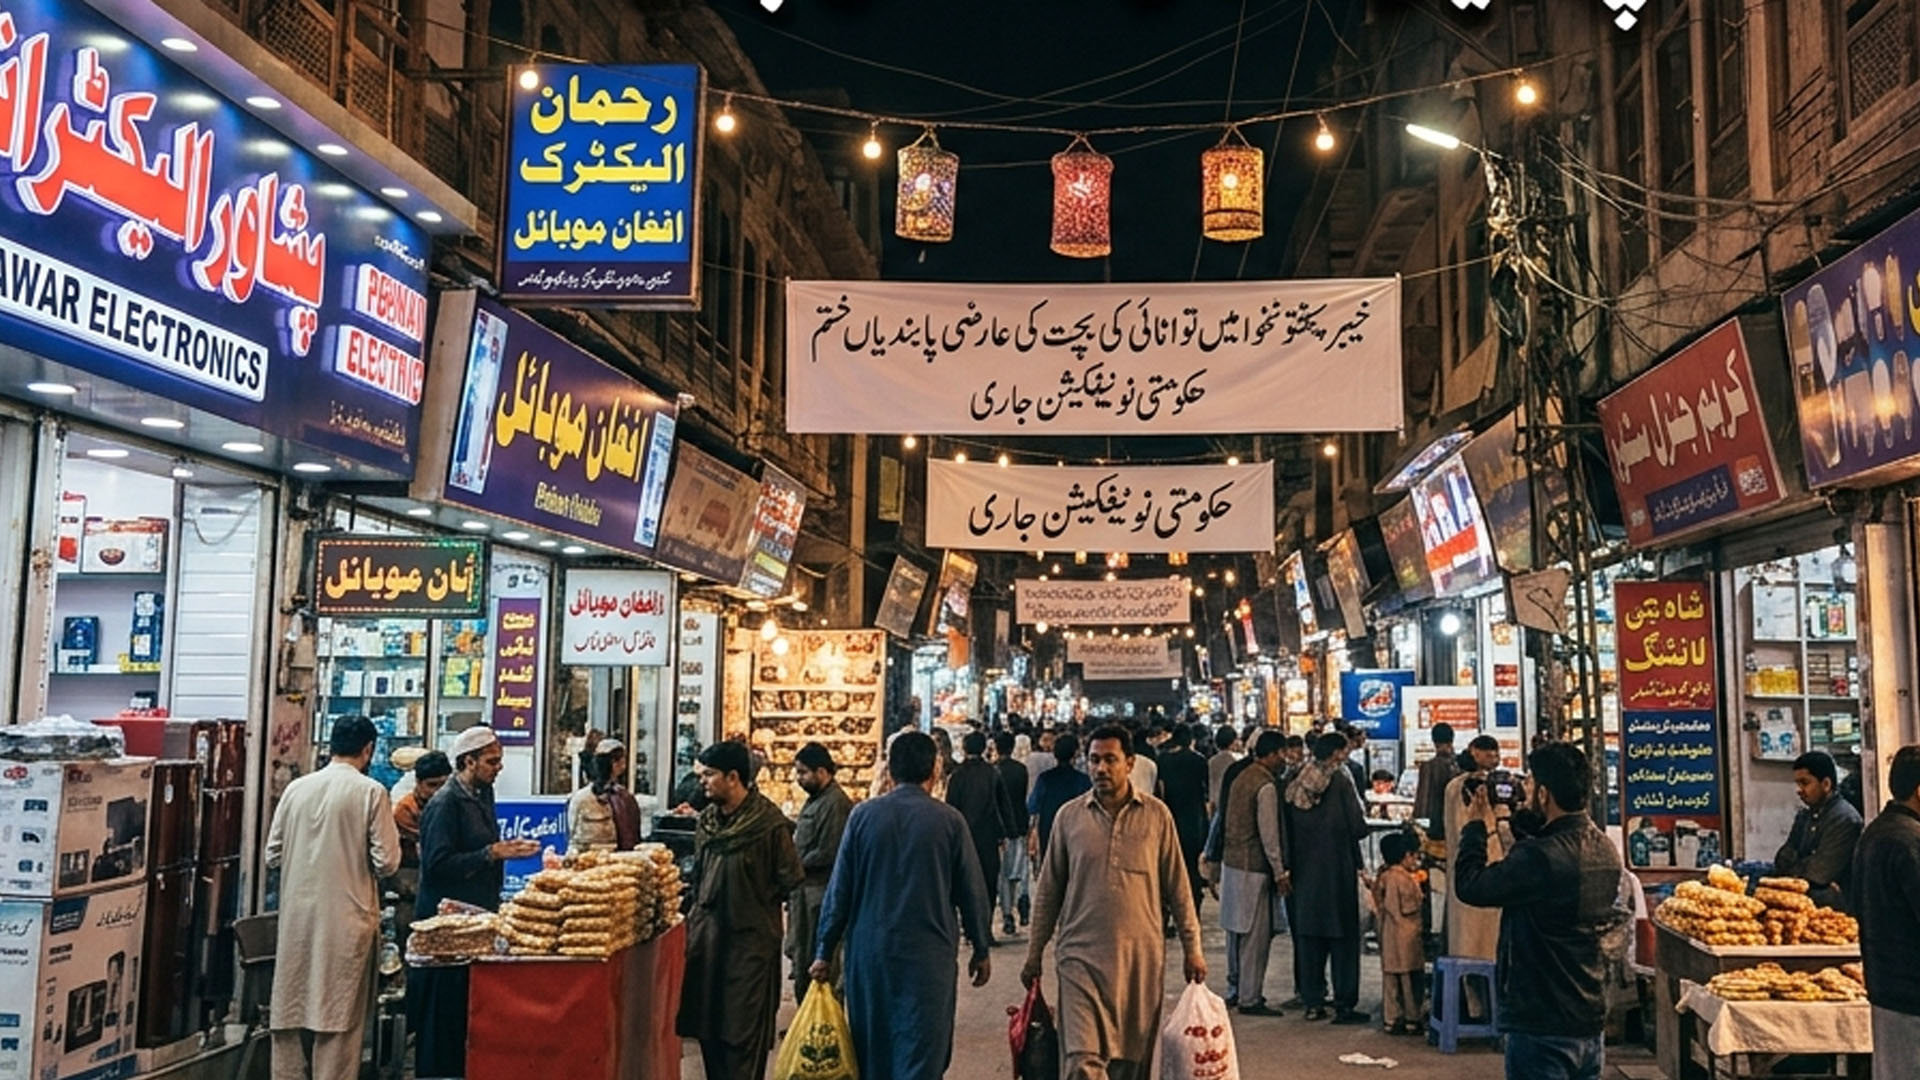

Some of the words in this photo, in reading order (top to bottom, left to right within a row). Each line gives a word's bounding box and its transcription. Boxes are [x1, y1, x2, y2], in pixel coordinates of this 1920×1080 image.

[530, 74, 678, 134] رحمان
[519, 140, 685, 194] الیکٹرک
[513, 209, 607, 250] موبائل
[611, 209, 684, 251] افغان
[193, 172, 326, 356] پشاور
[89, 286, 262, 390] ELECTRONICS
[811, 294, 852, 363] ختم
[942, 301, 1011, 352] عارضی
[1014, 299, 1049, 352] کی
[1042, 313, 1095, 361] بچت
[1099, 299, 1132, 352] کی
[1199, 309, 1240, 352] میں
[1324, 301, 1371, 352] خیبر
[495, 350, 588, 471] موبائل
[970, 380, 1033, 425] جاری
[1697, 348, 1750, 454] کریم
[585, 396, 649, 484] افغان
[968, 493, 1037, 543] جاری
